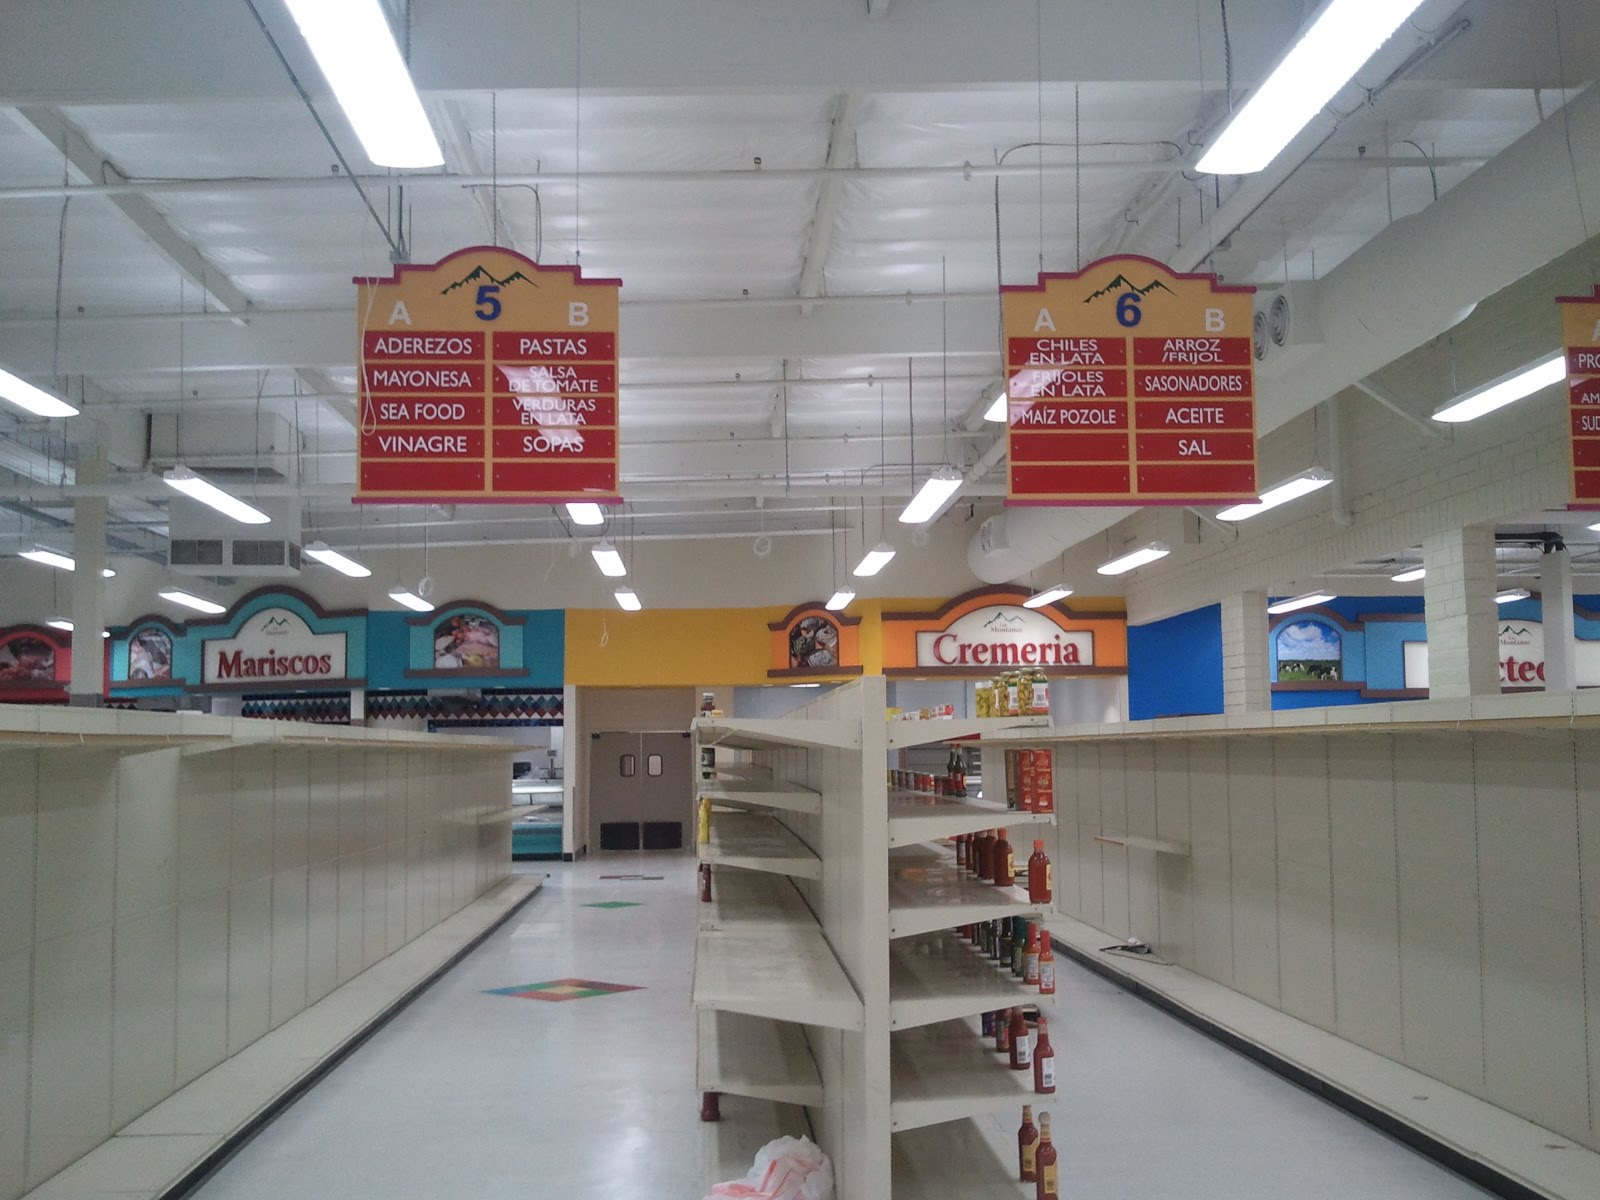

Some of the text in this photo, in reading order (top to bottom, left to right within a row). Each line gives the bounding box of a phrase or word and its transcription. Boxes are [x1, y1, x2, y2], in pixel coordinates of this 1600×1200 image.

[475, 285, 502, 321] 5
[1116, 292, 1142, 328] 6
[388, 301, 412, 326] A
[568, 302, 590, 327] B
[1033, 308, 1056, 332] A
[1205, 308, 1226, 332] B
[374, 338, 473, 355] ADEREZOS
[519, 338, 588, 356] PASTAS
[1036, 339, 1098, 351] CHILES
[1163, 339, 1222, 352] ARROZ
[1029, 352, 1105, 365] EN LATA
[1161, 351, 1223, 365] /FRIJOL
[373, 370, 472, 388] MAYONESA
[529, 366, 577, 379] SALSA
[1032, 370, 1104, 386] FRIJOLES
[508, 379, 599, 392] DE TOMATE
[1031, 384, 1106, 397] EN LATA
[1145, 375, 1243, 392] SASONADORES
[380, 403, 466, 421] SEA FOOD
[512, 399, 596, 411] VERDURAS
[521, 412, 587, 425] EN LATA
[1021, 405, 1117, 425] MAÍZ POZOLE
[1165, 408, 1225, 424] ACEITE
[378, 436, 468, 453] VINAGRE
[523, 436, 585, 453] SOPAS
[1178, 440, 1212, 456] SAL
[932, 633, 1080, 665] Cremeria
[216, 648, 332, 679] Mariscos
